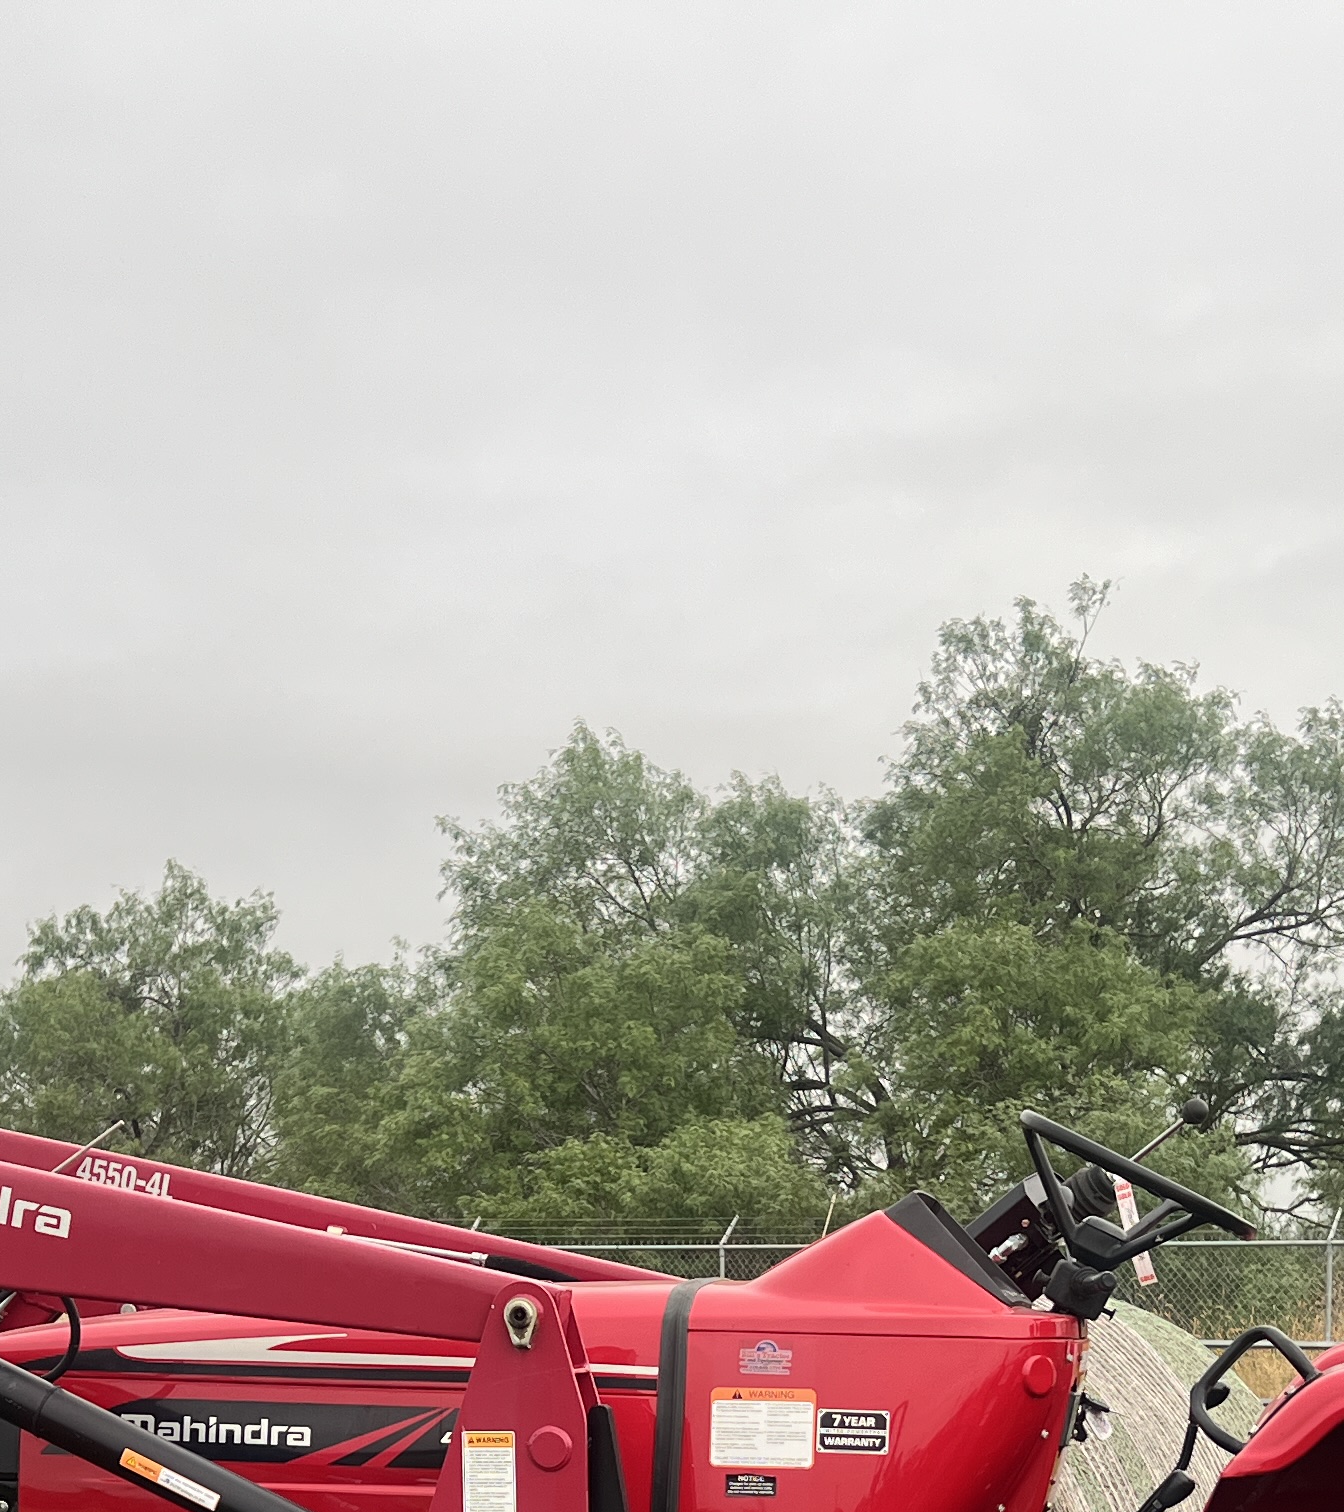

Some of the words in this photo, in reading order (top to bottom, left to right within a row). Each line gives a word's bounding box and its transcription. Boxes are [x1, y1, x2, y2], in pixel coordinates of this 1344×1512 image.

[76, 1156, 173, 1199] 4550-4L
[748, 1390, 795, 1399] WARNING
[831, 1414, 842, 1427] 7
[843, 1416, 876, 1428] YEAR
[823, 1436, 882, 1448] WARRANTY
